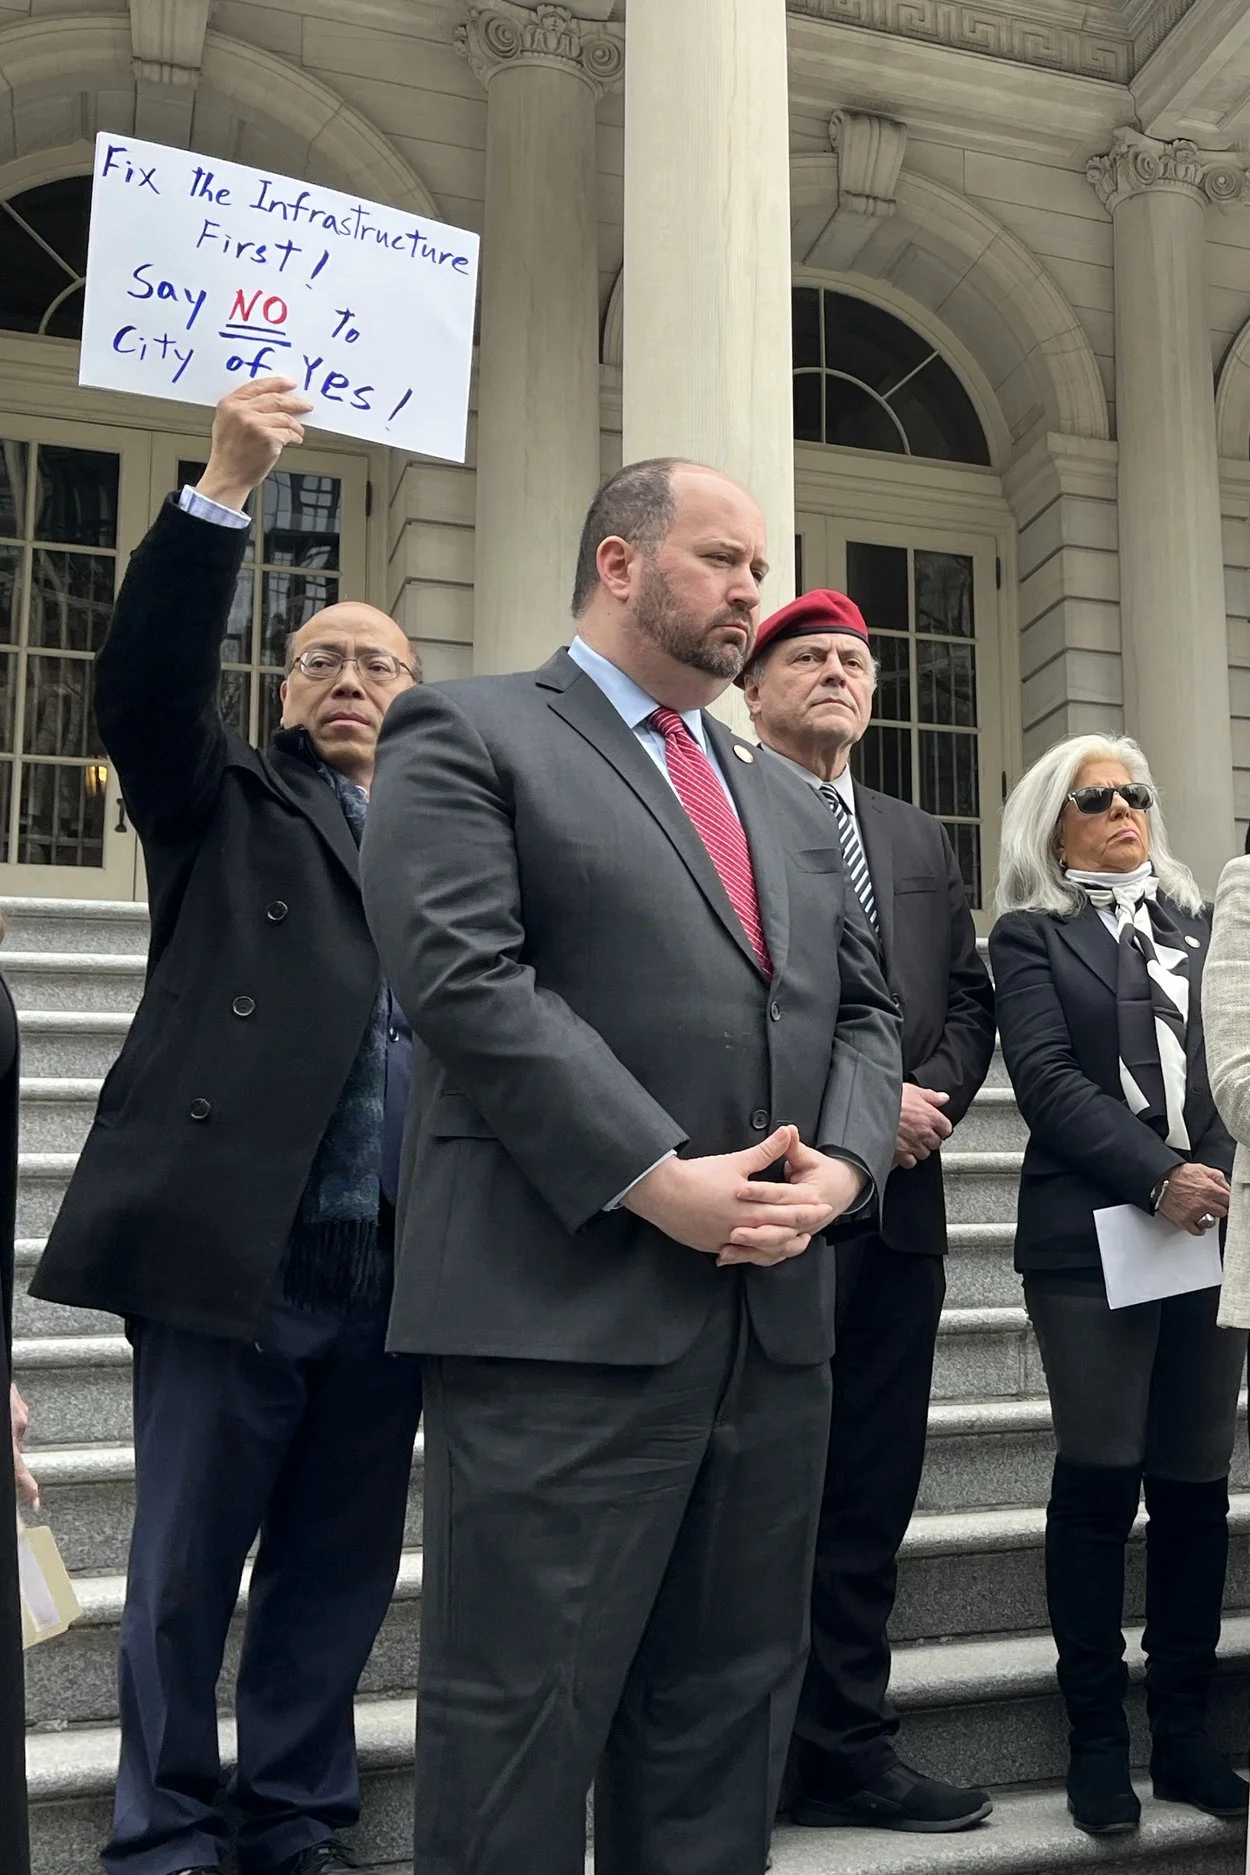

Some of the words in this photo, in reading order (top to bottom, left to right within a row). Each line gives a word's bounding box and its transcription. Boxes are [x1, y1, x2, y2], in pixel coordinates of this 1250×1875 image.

[101, 144, 161, 196] Fix
[190, 166, 232, 207] the
[249, 179, 470, 276] Infrastructure
[127, 263, 207, 330] Say
[228, 288, 288, 325] NO
[112, 324, 195, 384] City
[225, 346, 274, 378] of
